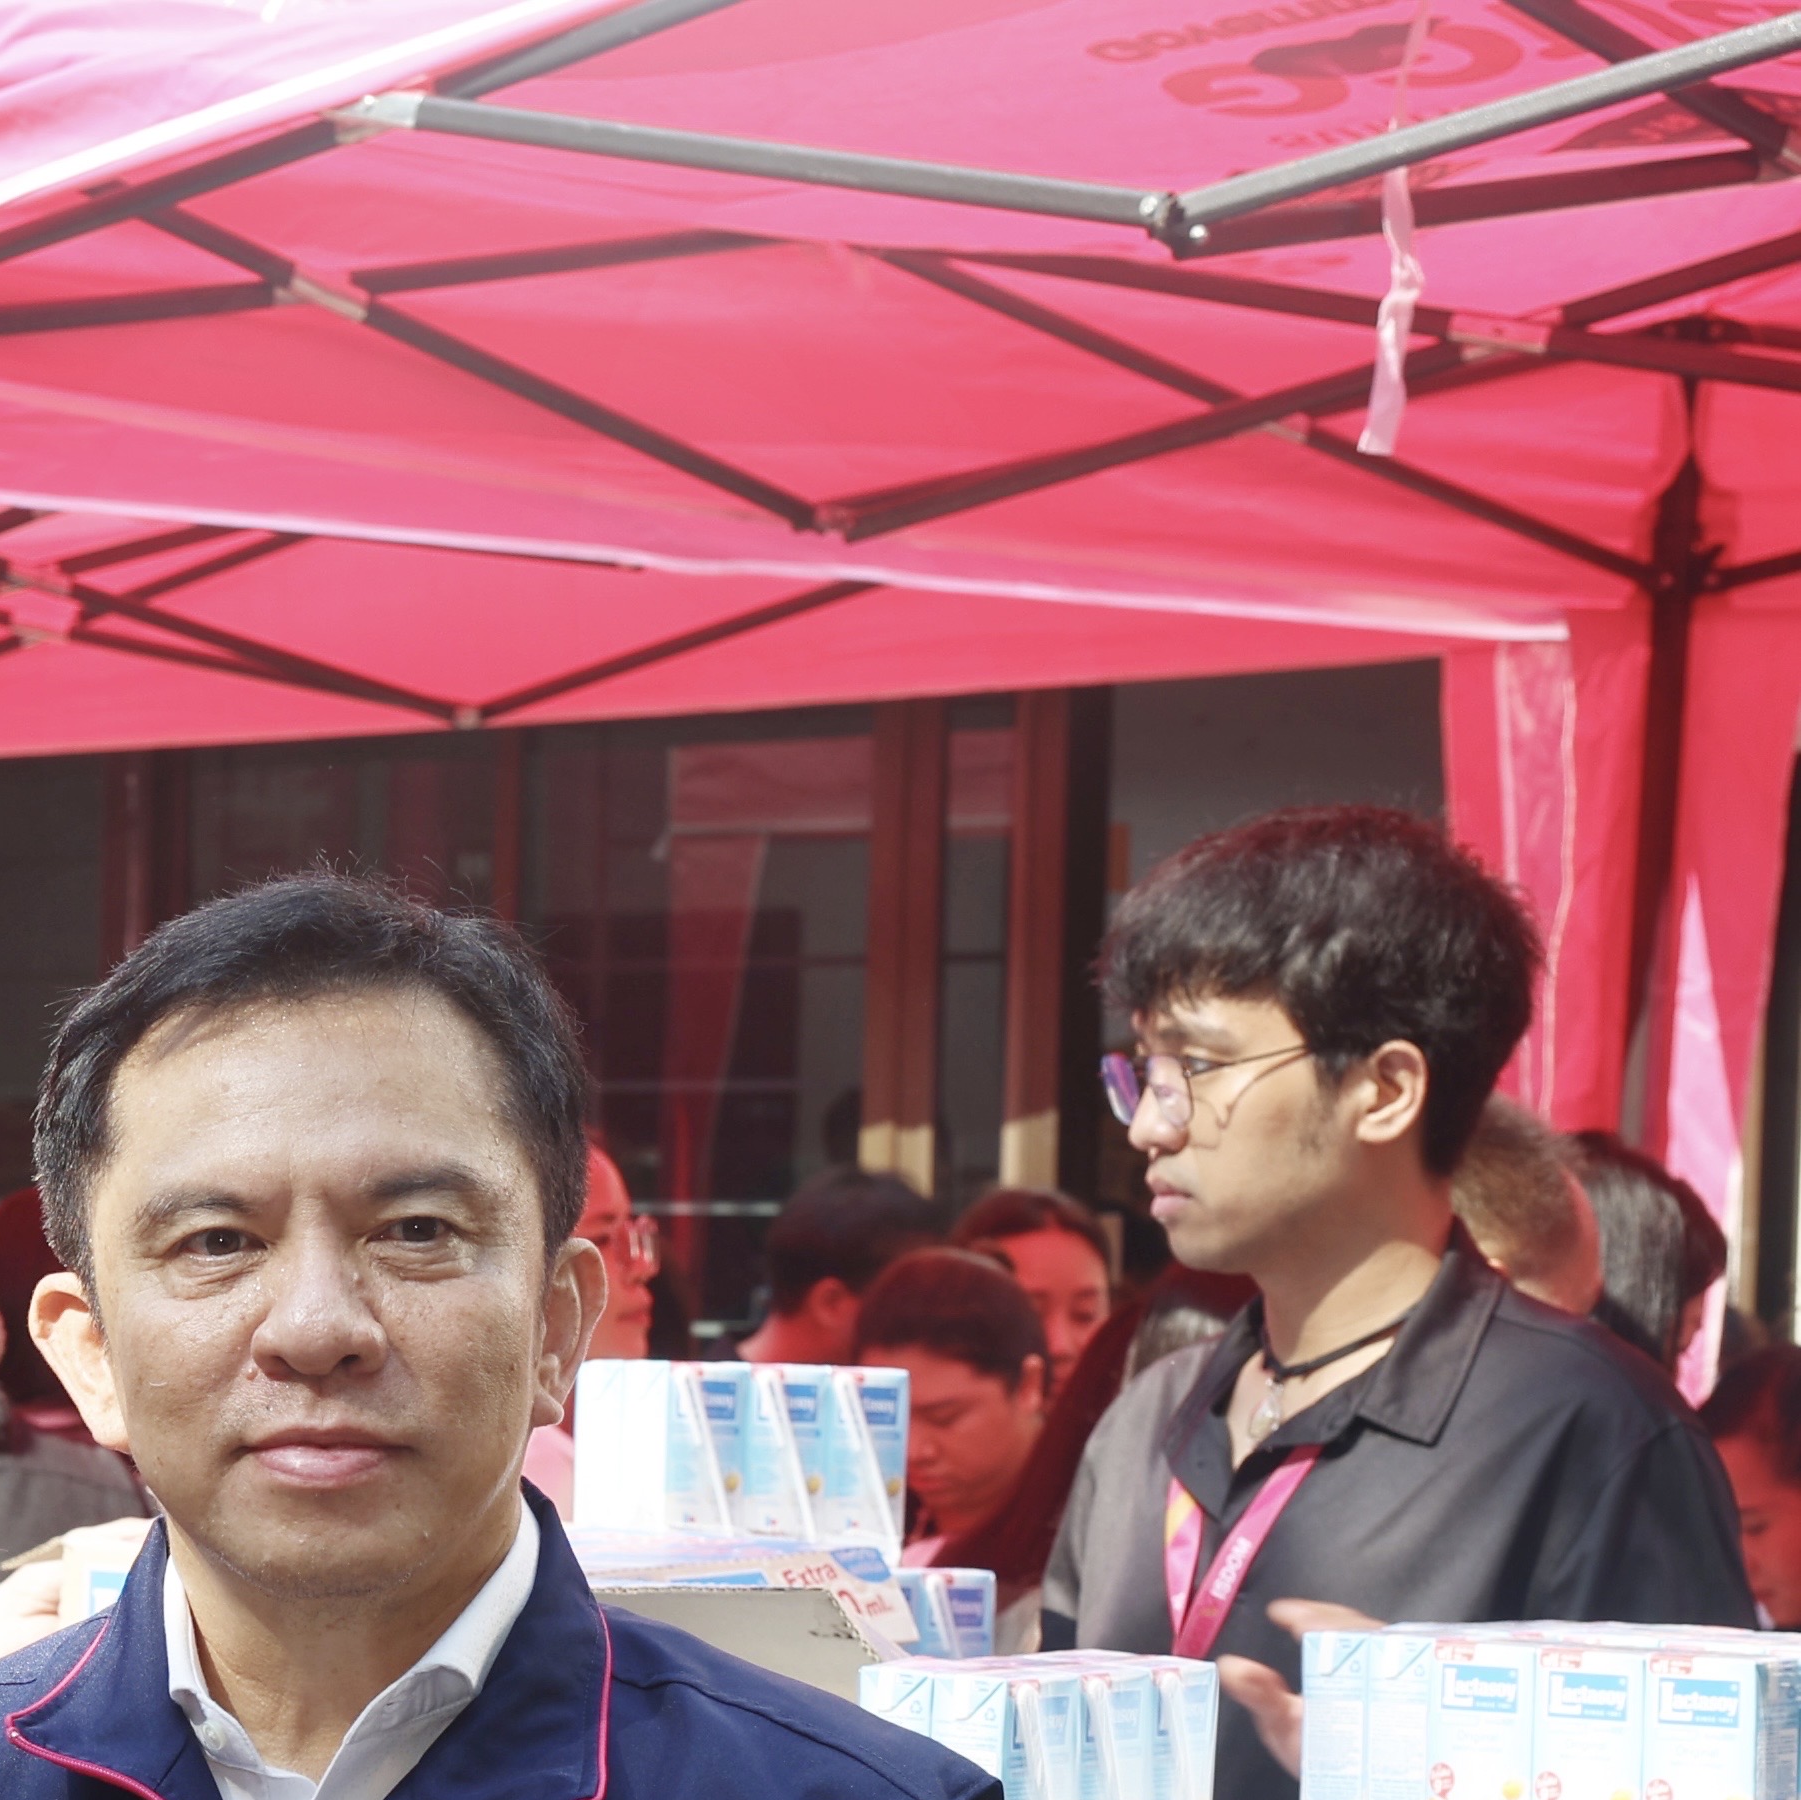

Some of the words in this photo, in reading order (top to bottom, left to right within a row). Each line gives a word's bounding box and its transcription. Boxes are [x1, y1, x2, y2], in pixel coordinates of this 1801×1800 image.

[1442, 1667, 1518, 1707] Lactasoy
[1549, 1675, 1627, 1715] Lactasoy
[1659, 1681, 1740, 1722] Lactasoy
